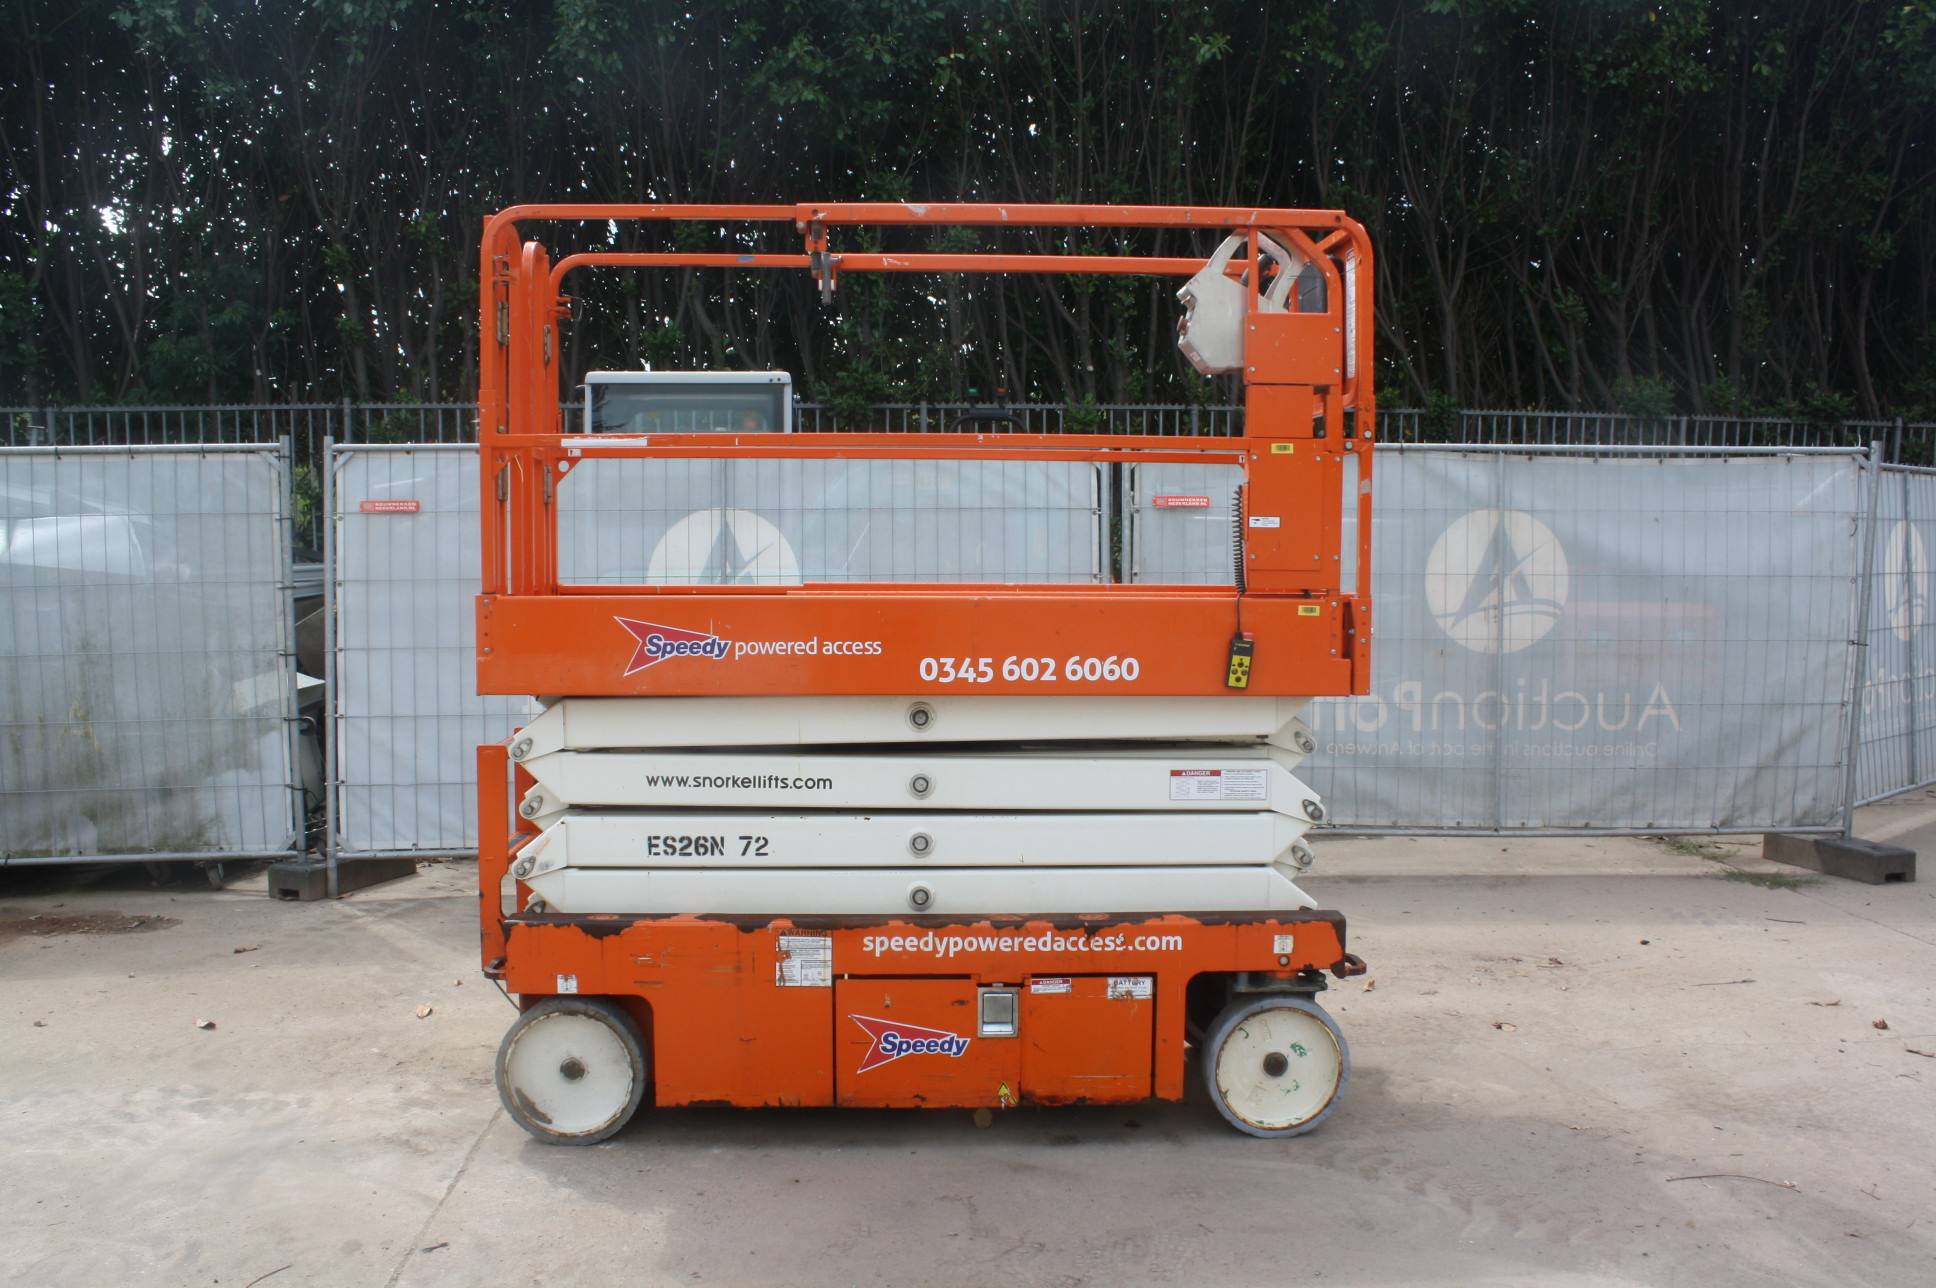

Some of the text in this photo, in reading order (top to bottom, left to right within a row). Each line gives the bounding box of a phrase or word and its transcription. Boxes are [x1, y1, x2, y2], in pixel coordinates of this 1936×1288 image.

[645, 634, 882, 660] Speedy powered access
[919, 656, 1139, 683] 0345 602 6060
[646, 774, 833, 791] www.snorkellifts.com
[647, 835, 769, 857] ES26N 72
[863, 931, 1183, 957] speedypoweredaccess.com
[879, 1032, 971, 1057] Speedy
